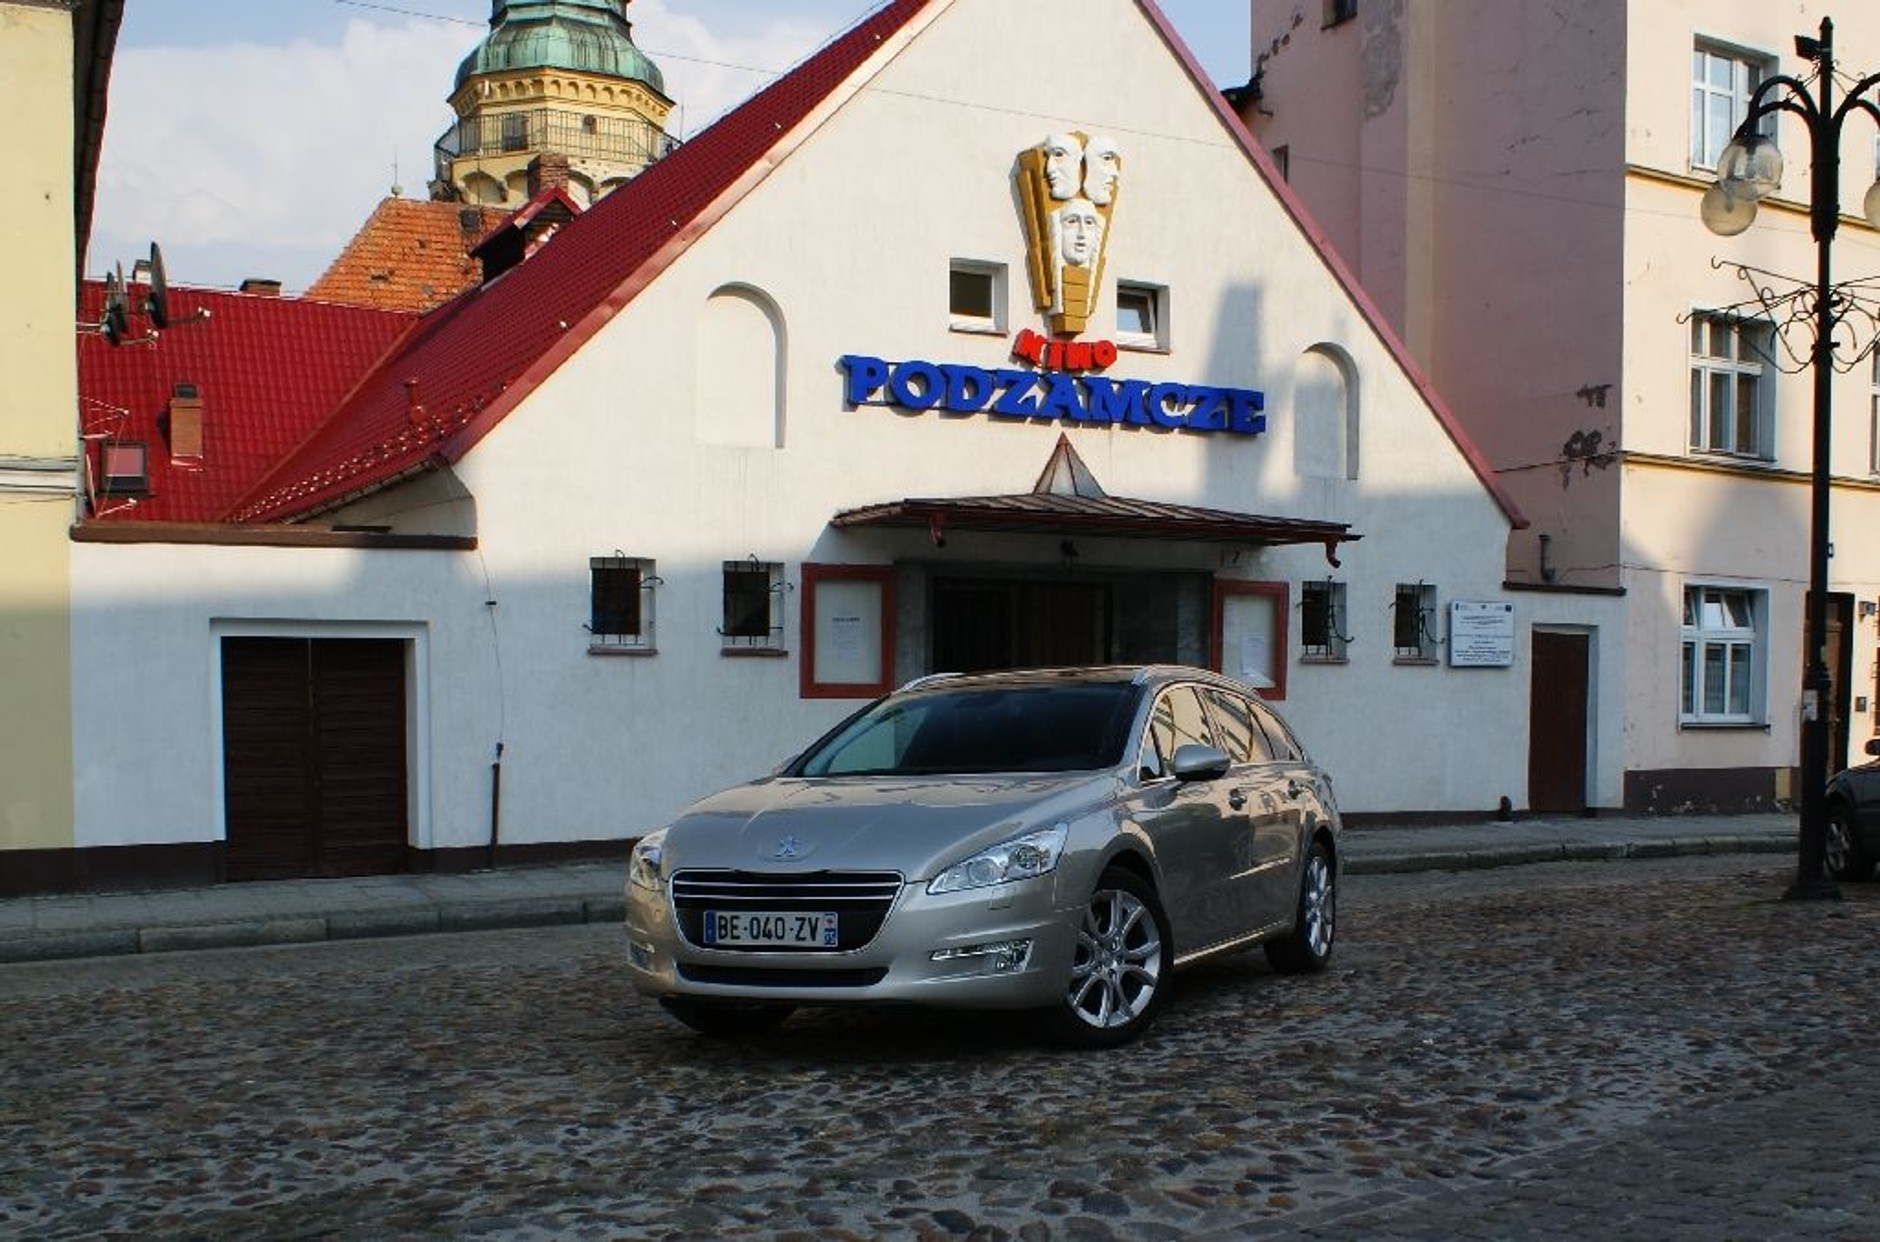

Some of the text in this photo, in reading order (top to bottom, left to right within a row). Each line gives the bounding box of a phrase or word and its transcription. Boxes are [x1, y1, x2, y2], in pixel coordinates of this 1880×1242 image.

[1013, 328, 1117, 370] KINO
[843, 355, 1266, 434] PODZAMCZE
[718, 915, 819, 942] BE-040-ZV
